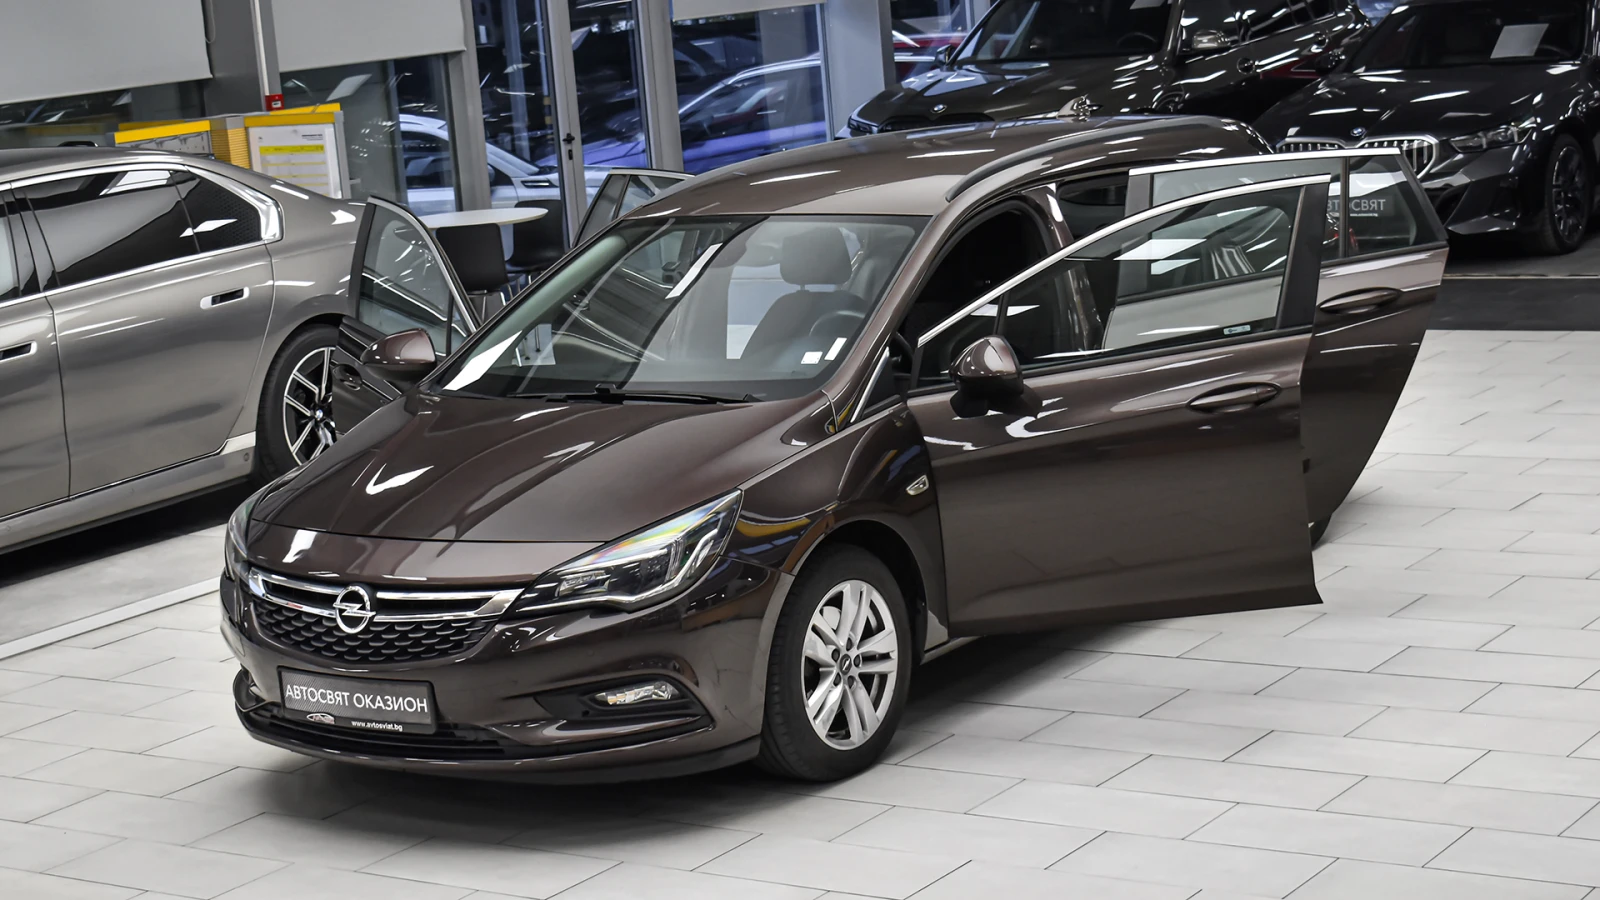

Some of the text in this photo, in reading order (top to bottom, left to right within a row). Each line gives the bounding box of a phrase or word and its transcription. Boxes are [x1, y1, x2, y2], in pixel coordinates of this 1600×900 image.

[285, 685, 428, 713] АВТОСВЯТ ОКАЗИОН
[351, 720, 403, 732] www.avtosviat.bg
